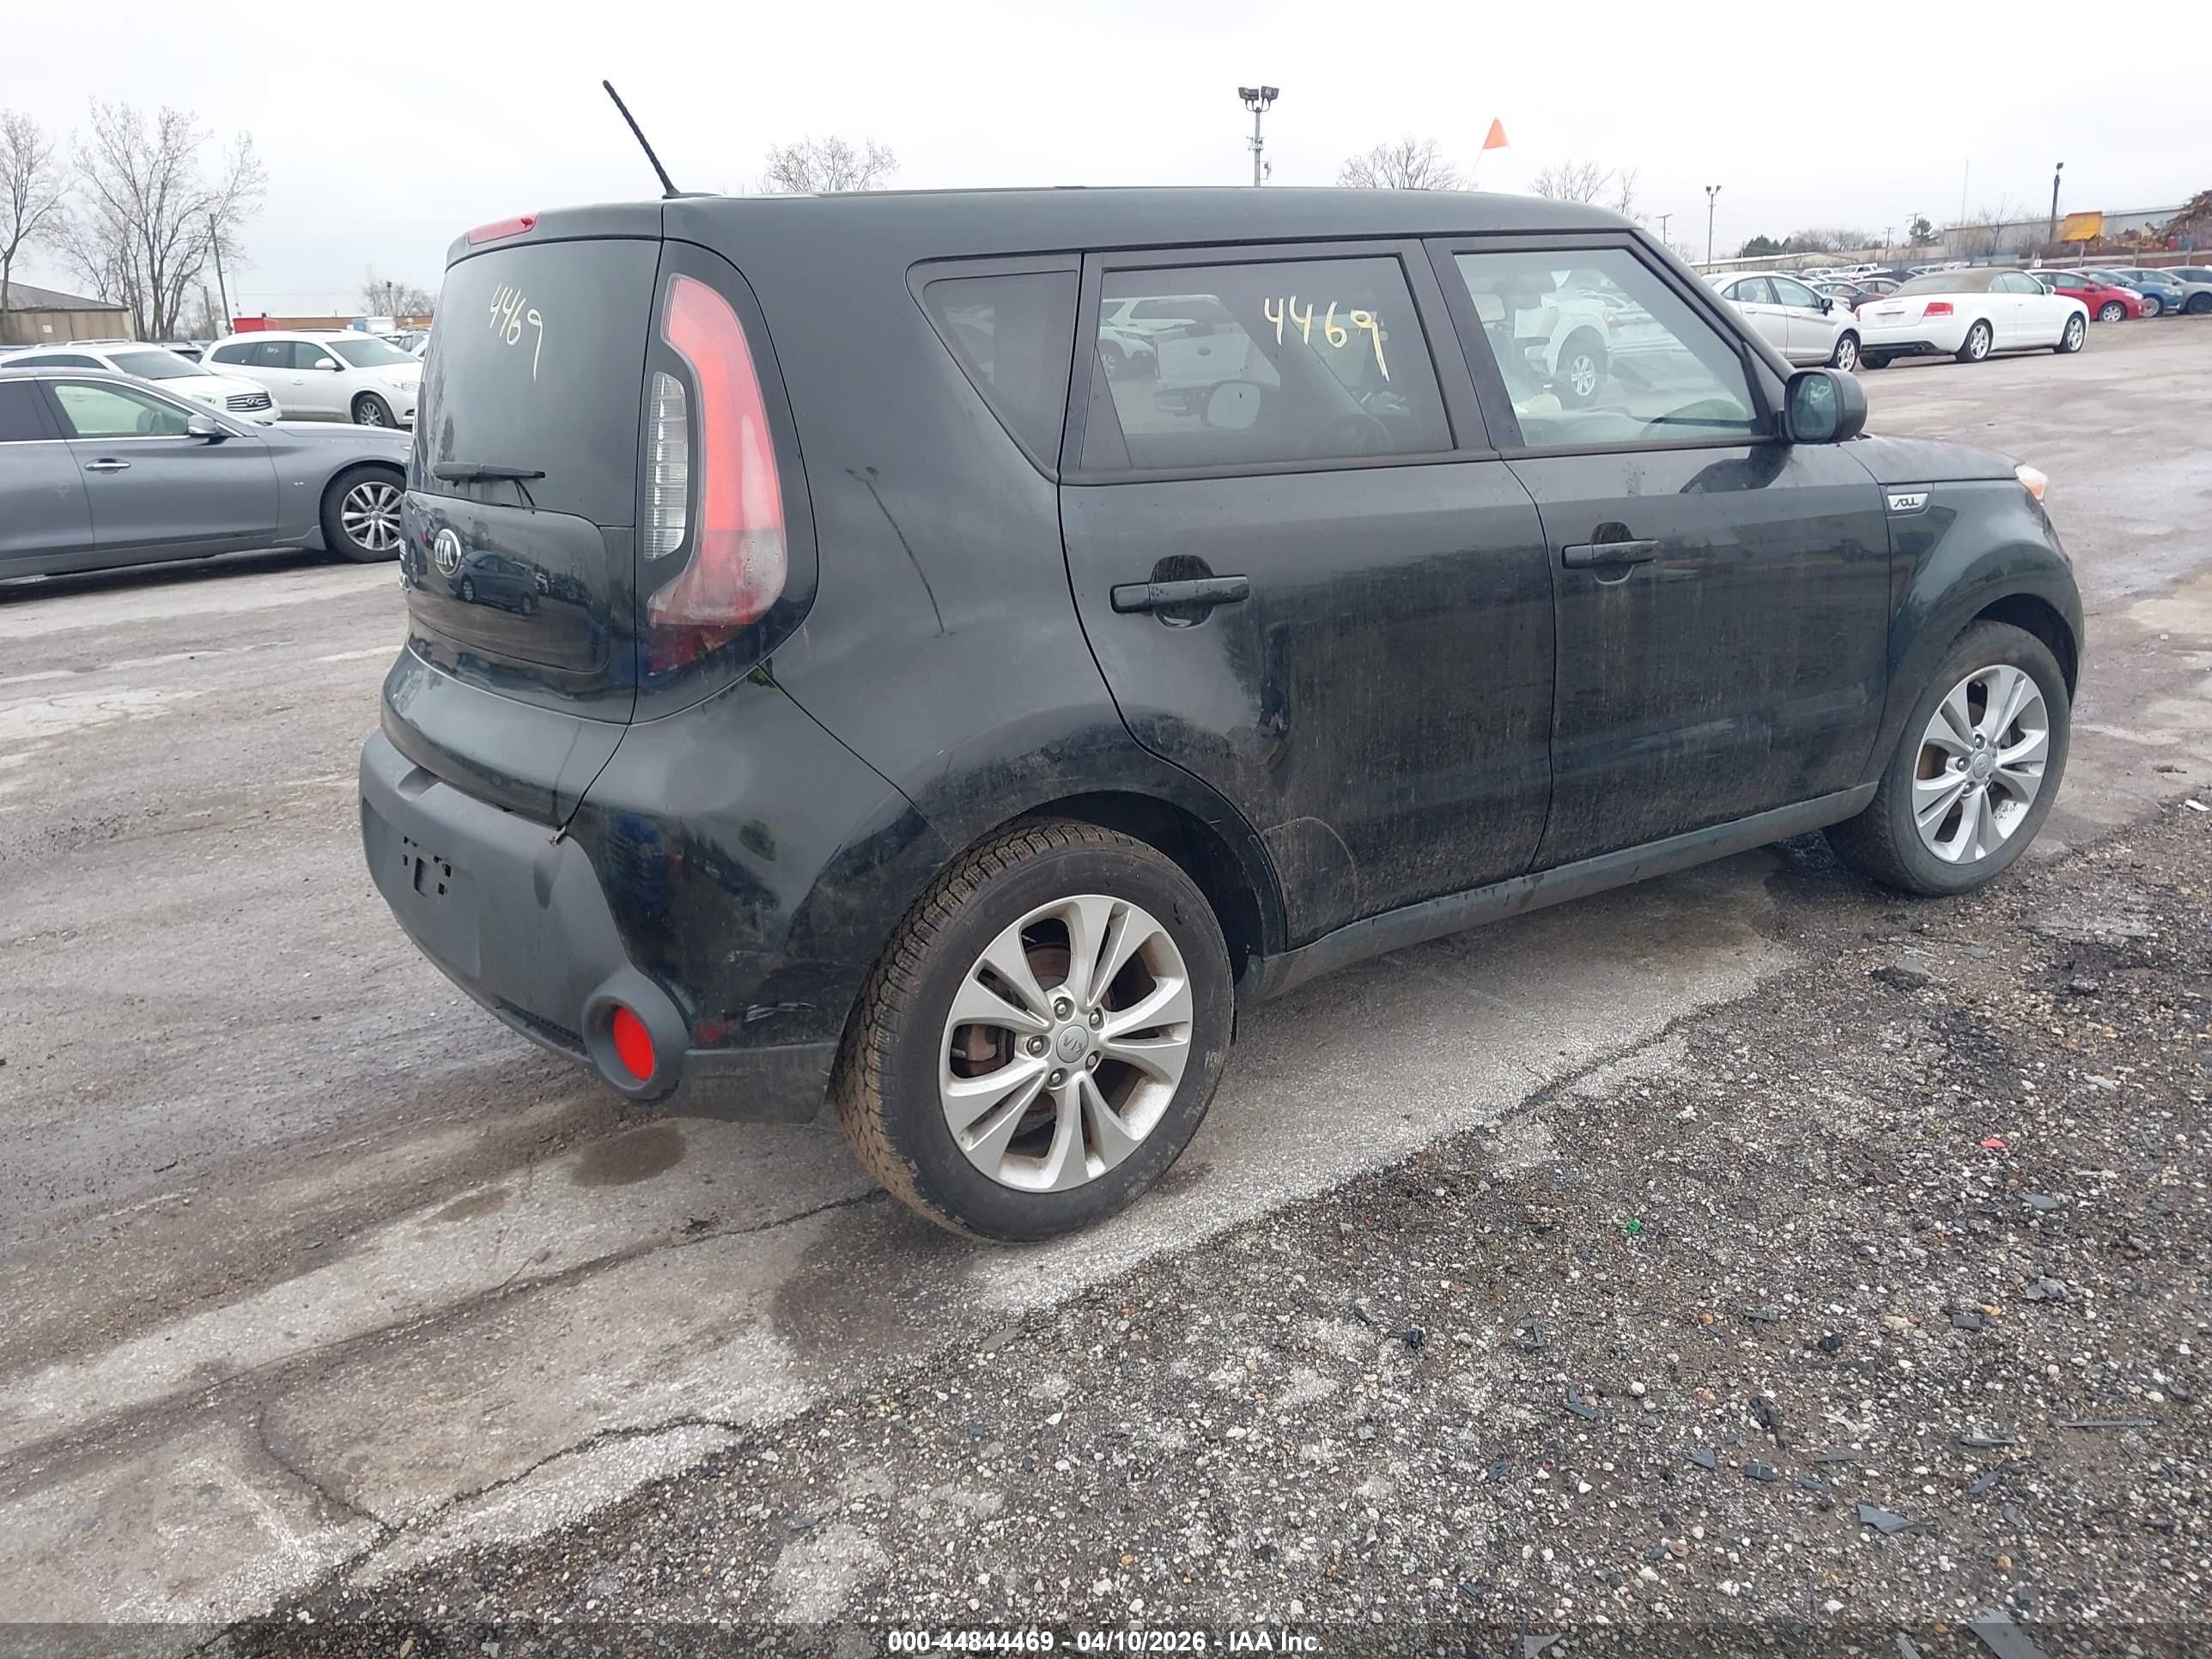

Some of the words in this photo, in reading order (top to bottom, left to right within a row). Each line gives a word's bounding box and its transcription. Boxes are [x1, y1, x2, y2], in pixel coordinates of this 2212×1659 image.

[489, 283, 543, 382] 4469
[1264, 295, 1390, 383] 4469
[1063, 1035, 1085, 1056] KIA
